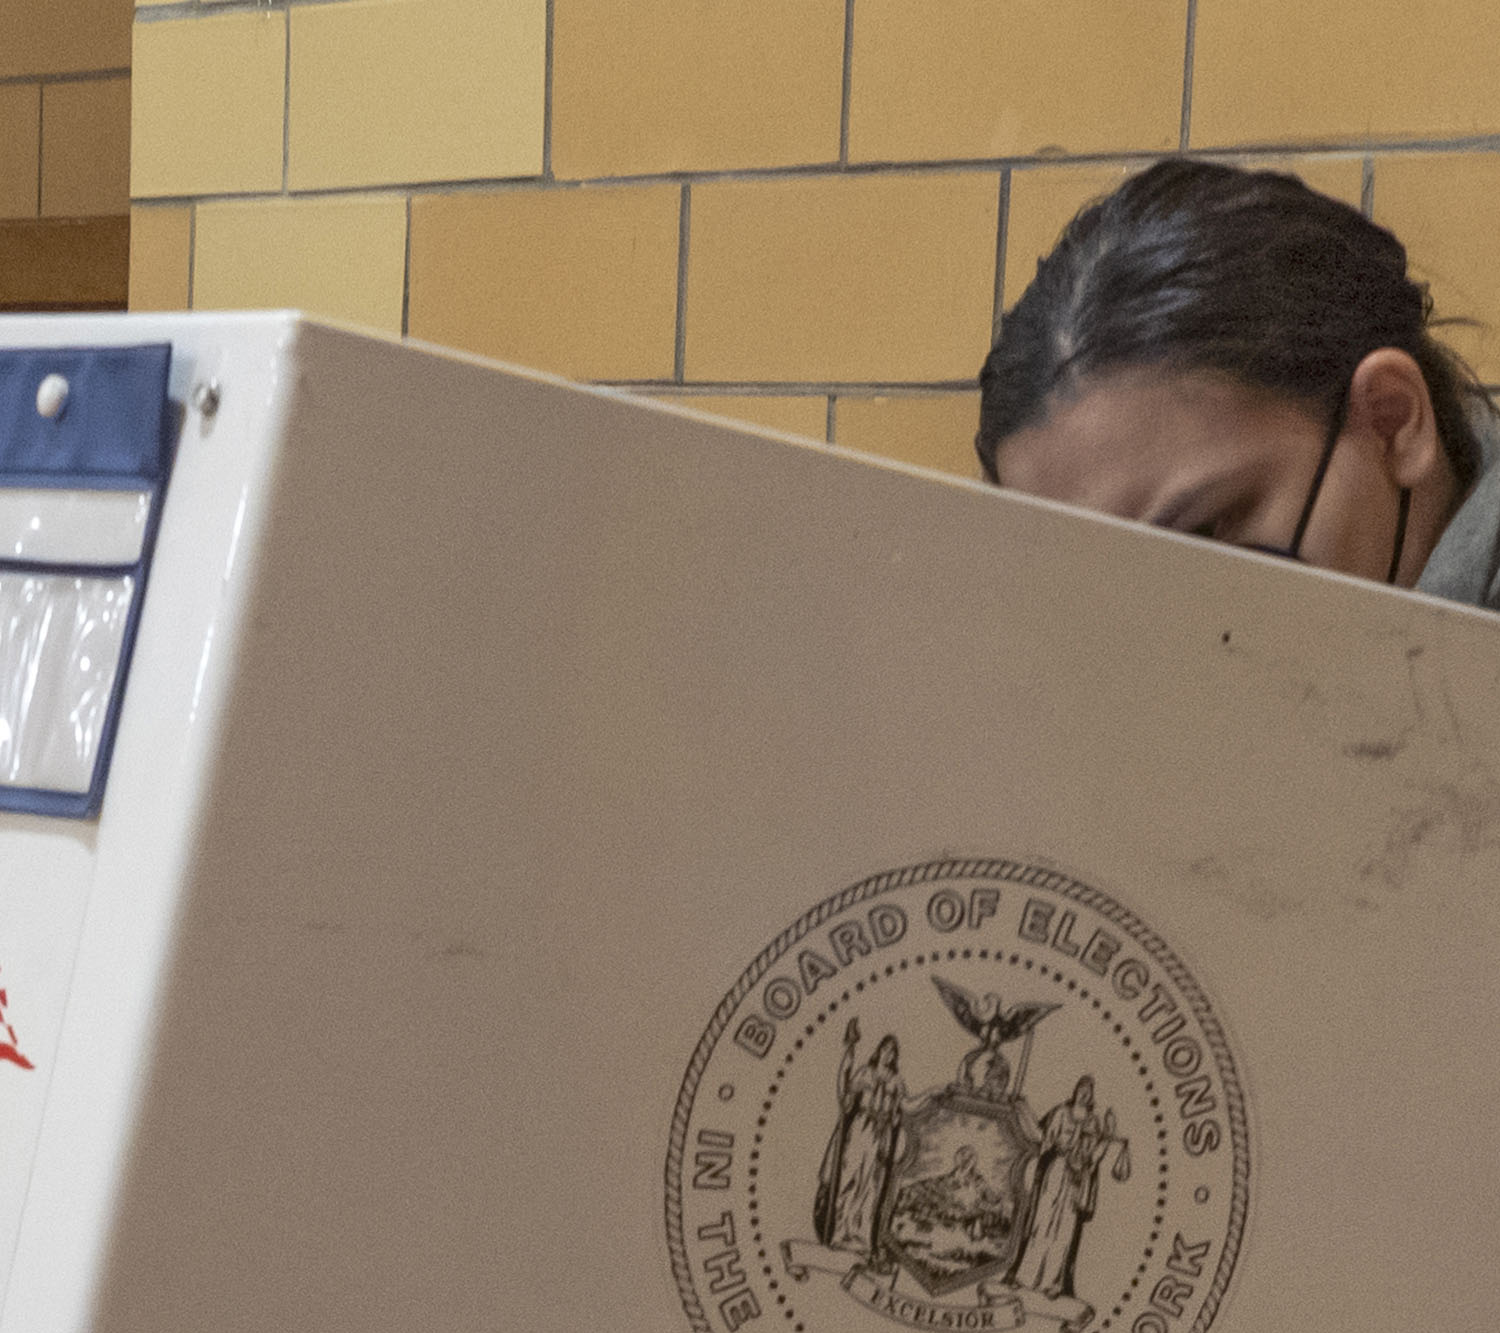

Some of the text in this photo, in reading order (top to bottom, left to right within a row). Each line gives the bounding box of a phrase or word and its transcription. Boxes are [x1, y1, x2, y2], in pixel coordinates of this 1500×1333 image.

[734, 889, 1220, 1156] BOARD OF ELECTIONS
[693, 1129, 734, 1190] IN
[698, 1211, 760, 1332] THE
[869, 1287, 996, 1329] EXCELSIOR
